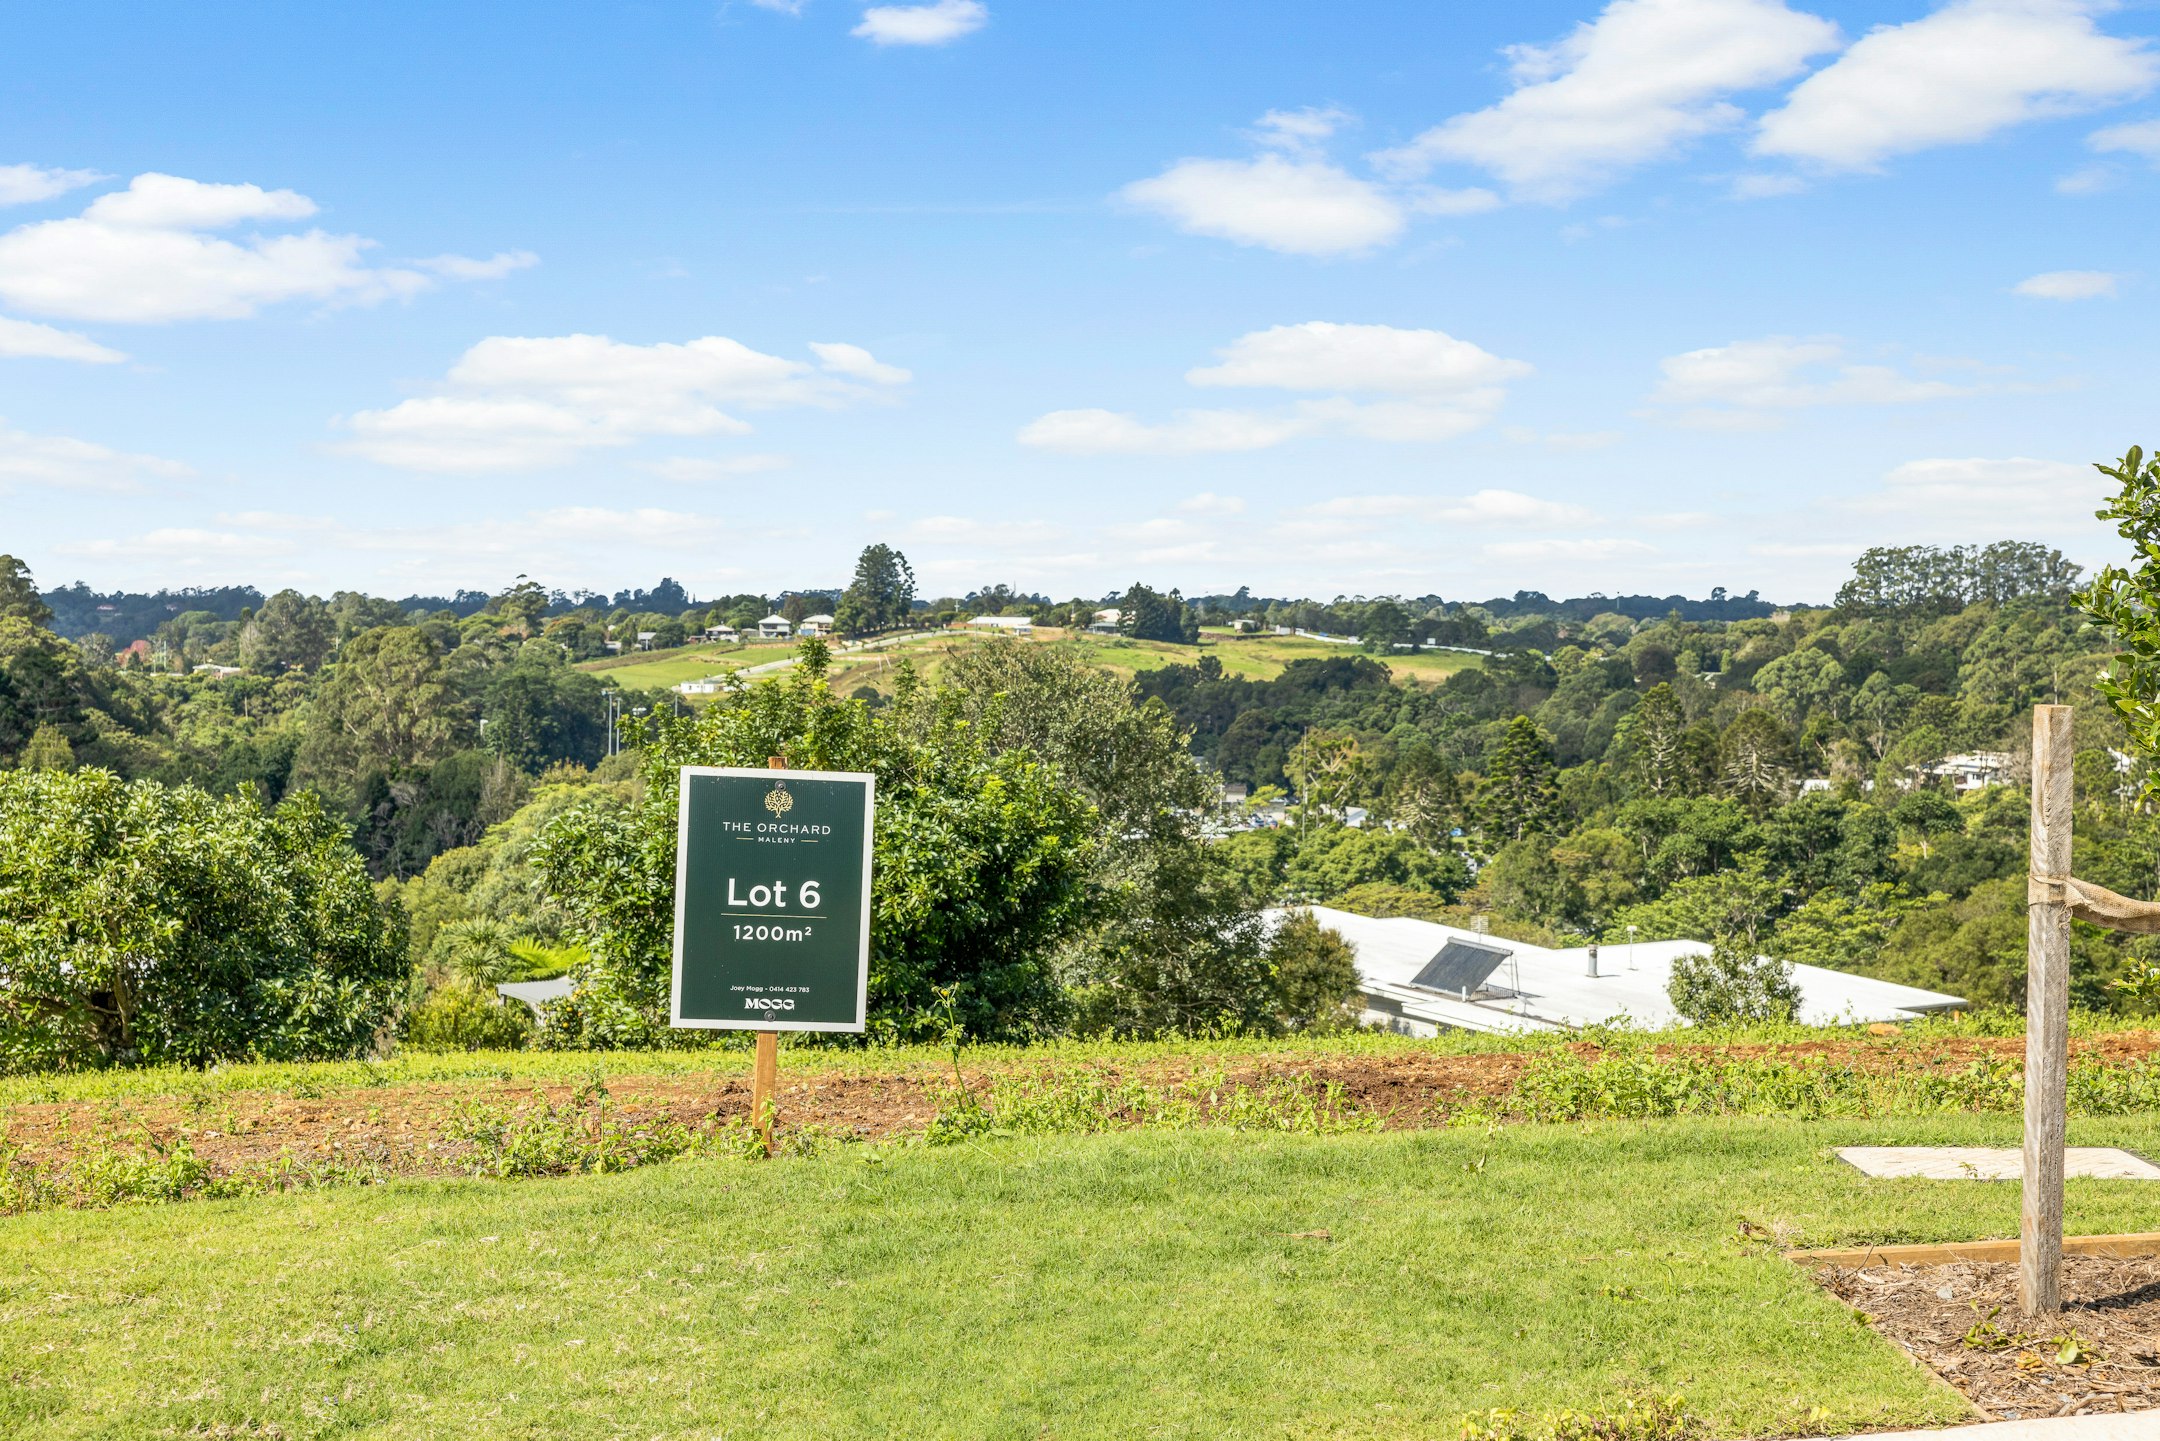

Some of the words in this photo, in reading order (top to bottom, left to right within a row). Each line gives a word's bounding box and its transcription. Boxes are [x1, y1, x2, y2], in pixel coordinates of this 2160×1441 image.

[723, 821, 752, 832] THE
[757, 823, 831, 835] ORCHARD
[758, 836, 796, 844] MALENY
[727, 878, 787, 908] Lot
[799, 880, 821, 909] 6
[746, 985, 763, 993] Mogg
[744, 998, 795, 1010] MOGG
